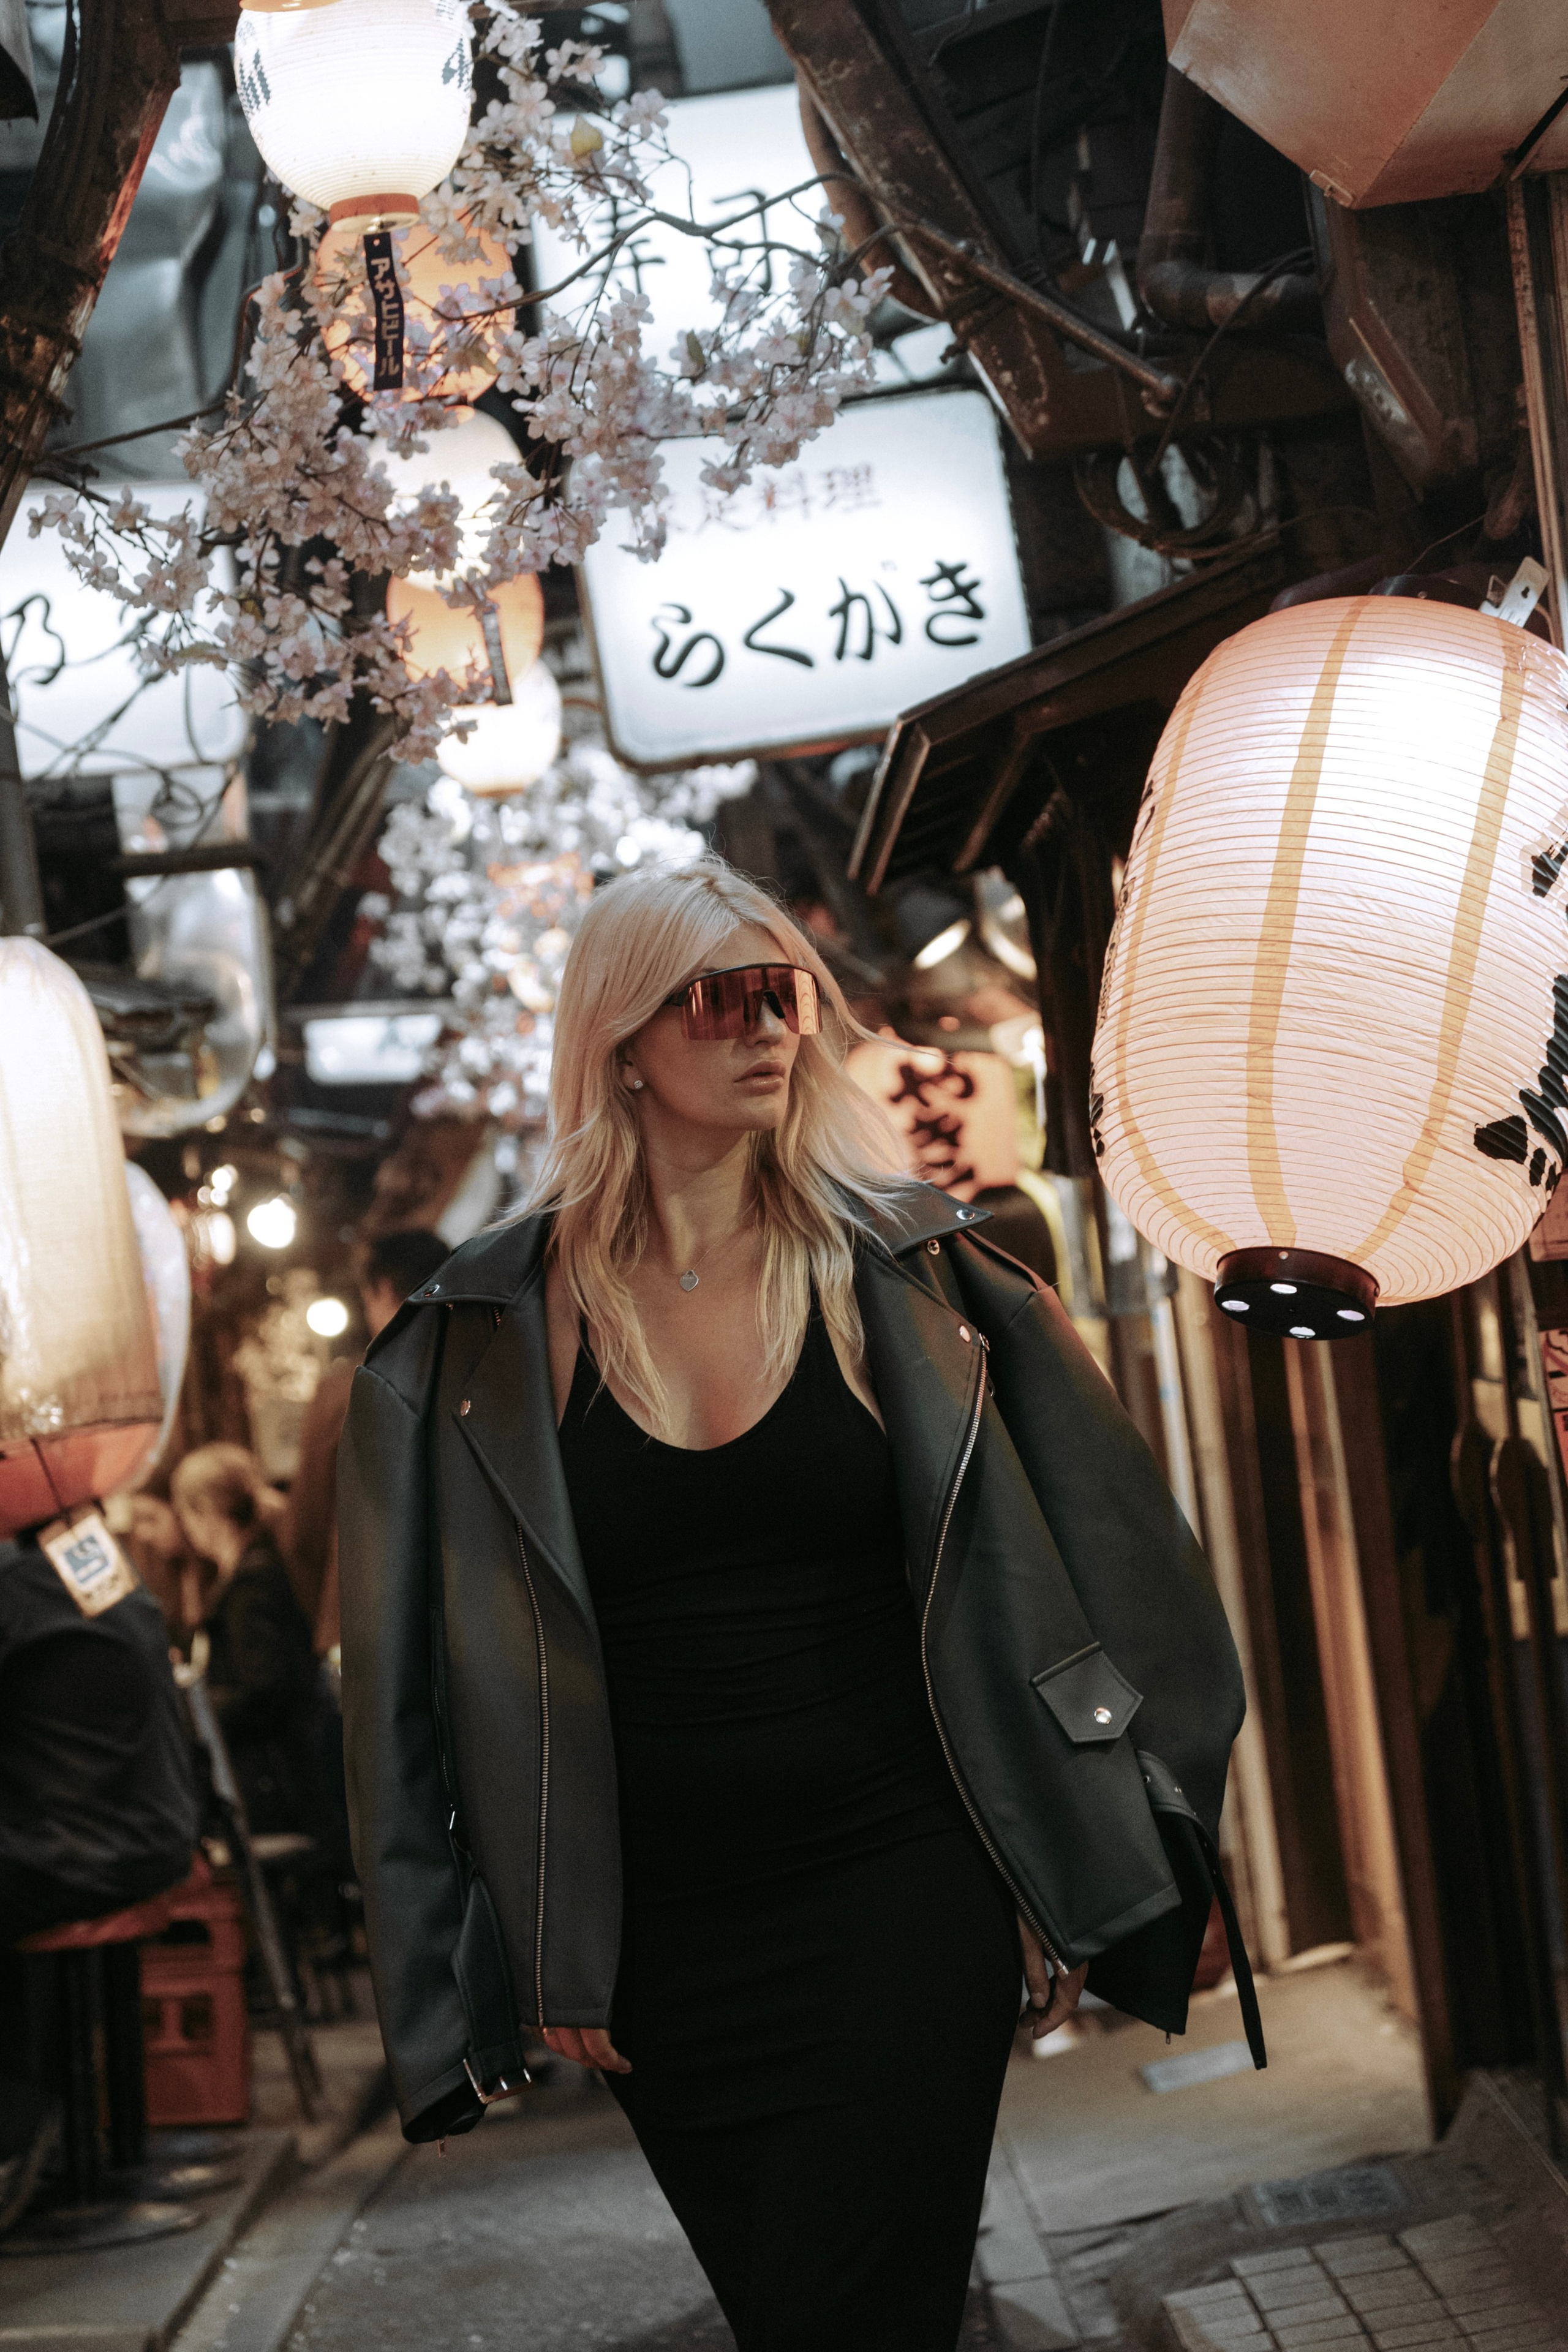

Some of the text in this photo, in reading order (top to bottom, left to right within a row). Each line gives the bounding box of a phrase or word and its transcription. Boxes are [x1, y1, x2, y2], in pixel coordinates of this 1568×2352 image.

[370, 257, 401, 377] アサヒビール
[651, 559, 984, 688] らくがき
